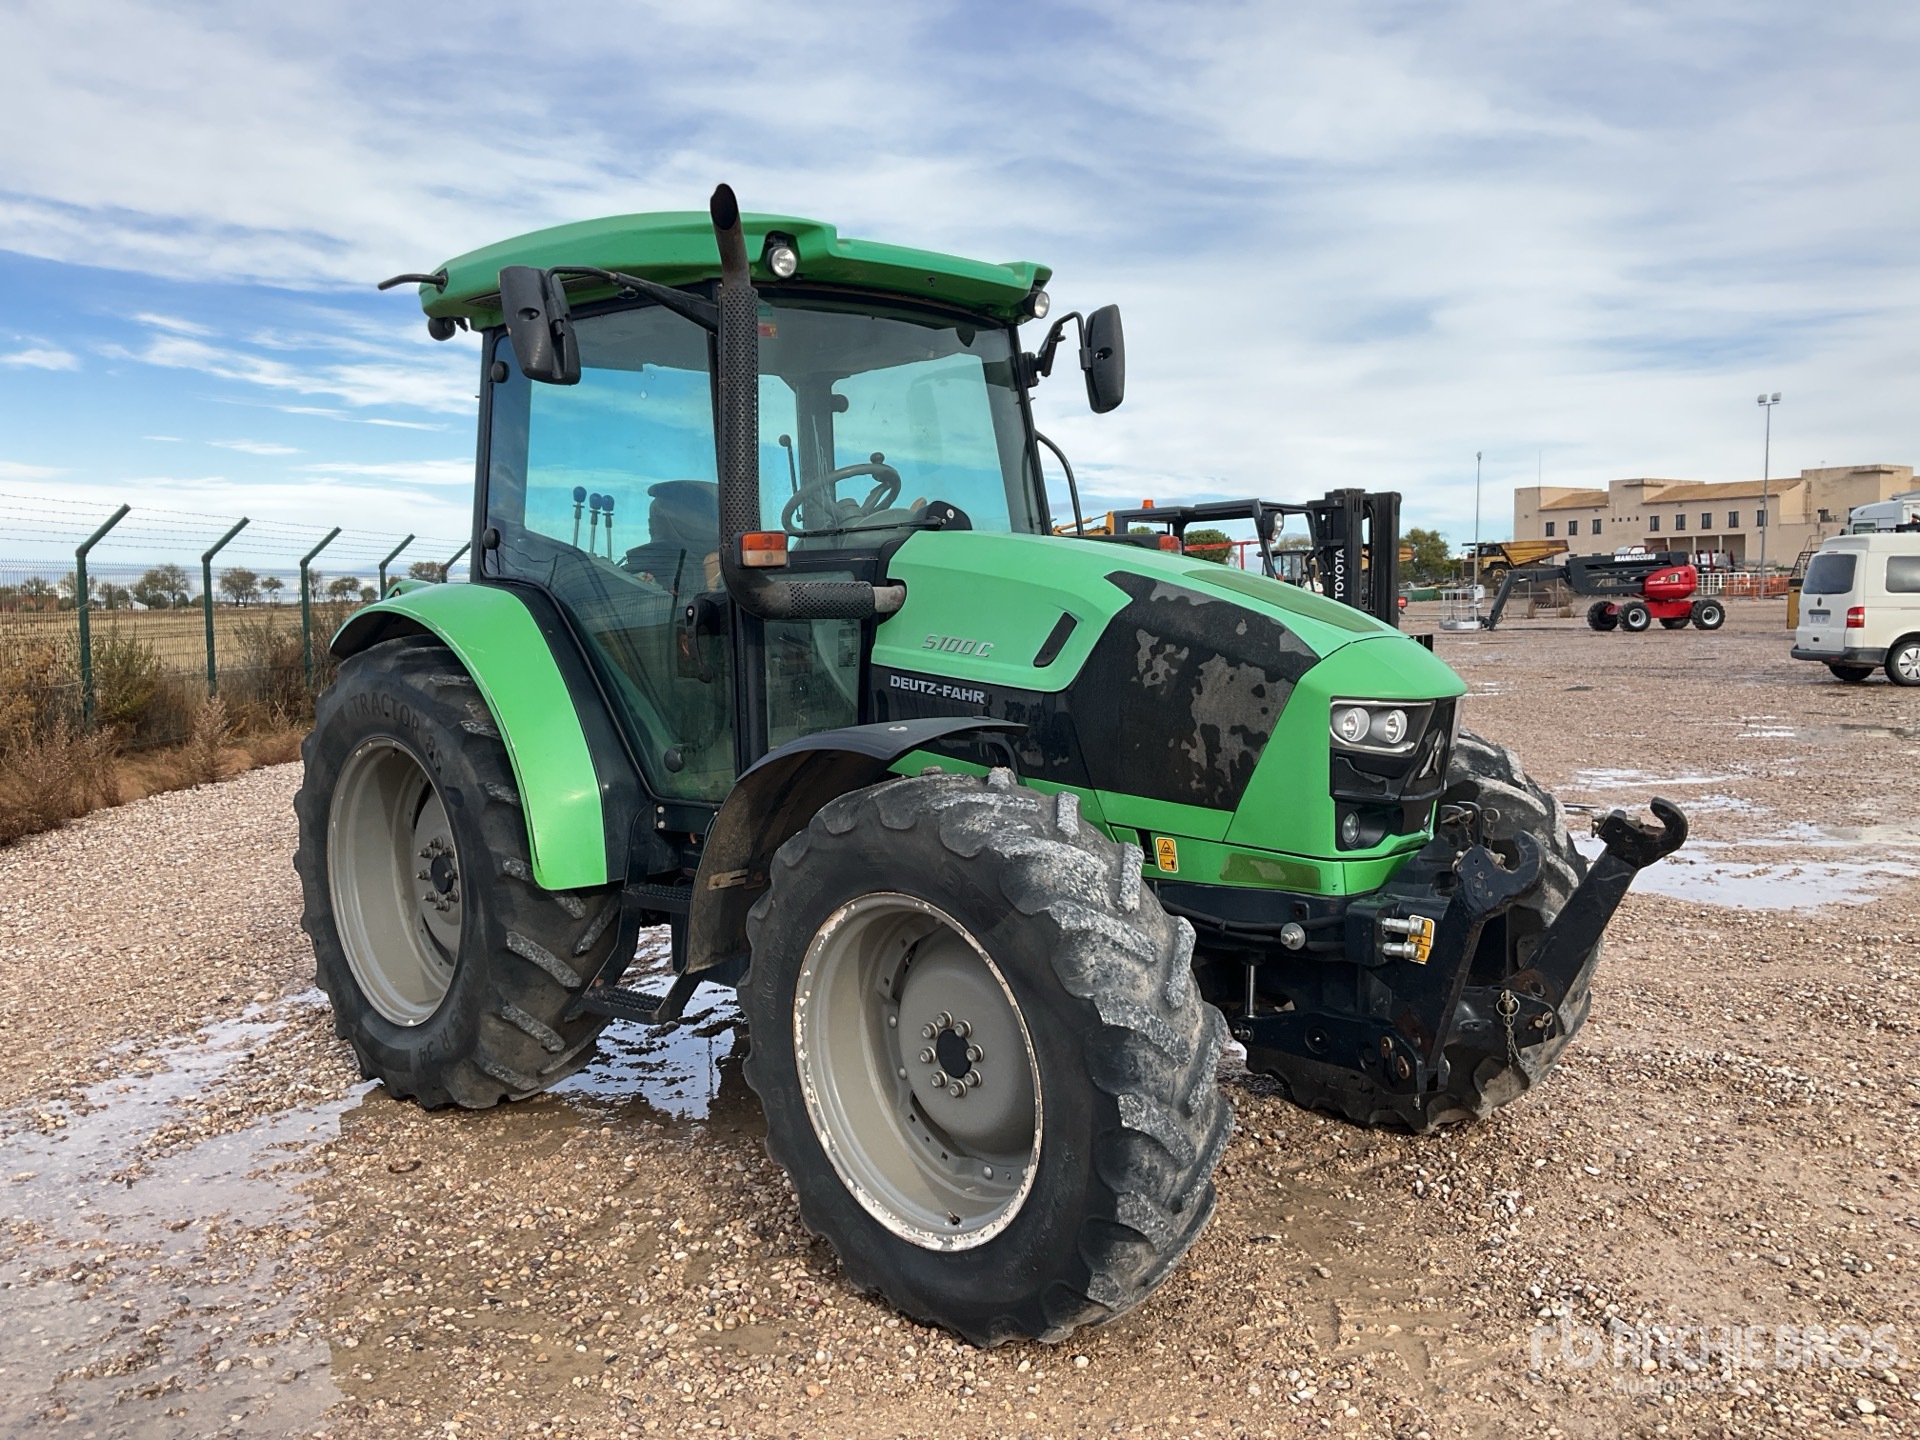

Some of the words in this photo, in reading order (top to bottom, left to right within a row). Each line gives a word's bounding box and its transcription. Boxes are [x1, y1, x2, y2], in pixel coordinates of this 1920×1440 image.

[1335, 549, 1345, 599] TOYOTA
[889, 674, 986, 705] DEUTZ-FAHR
[350, 691, 421, 738] TRACTOR
